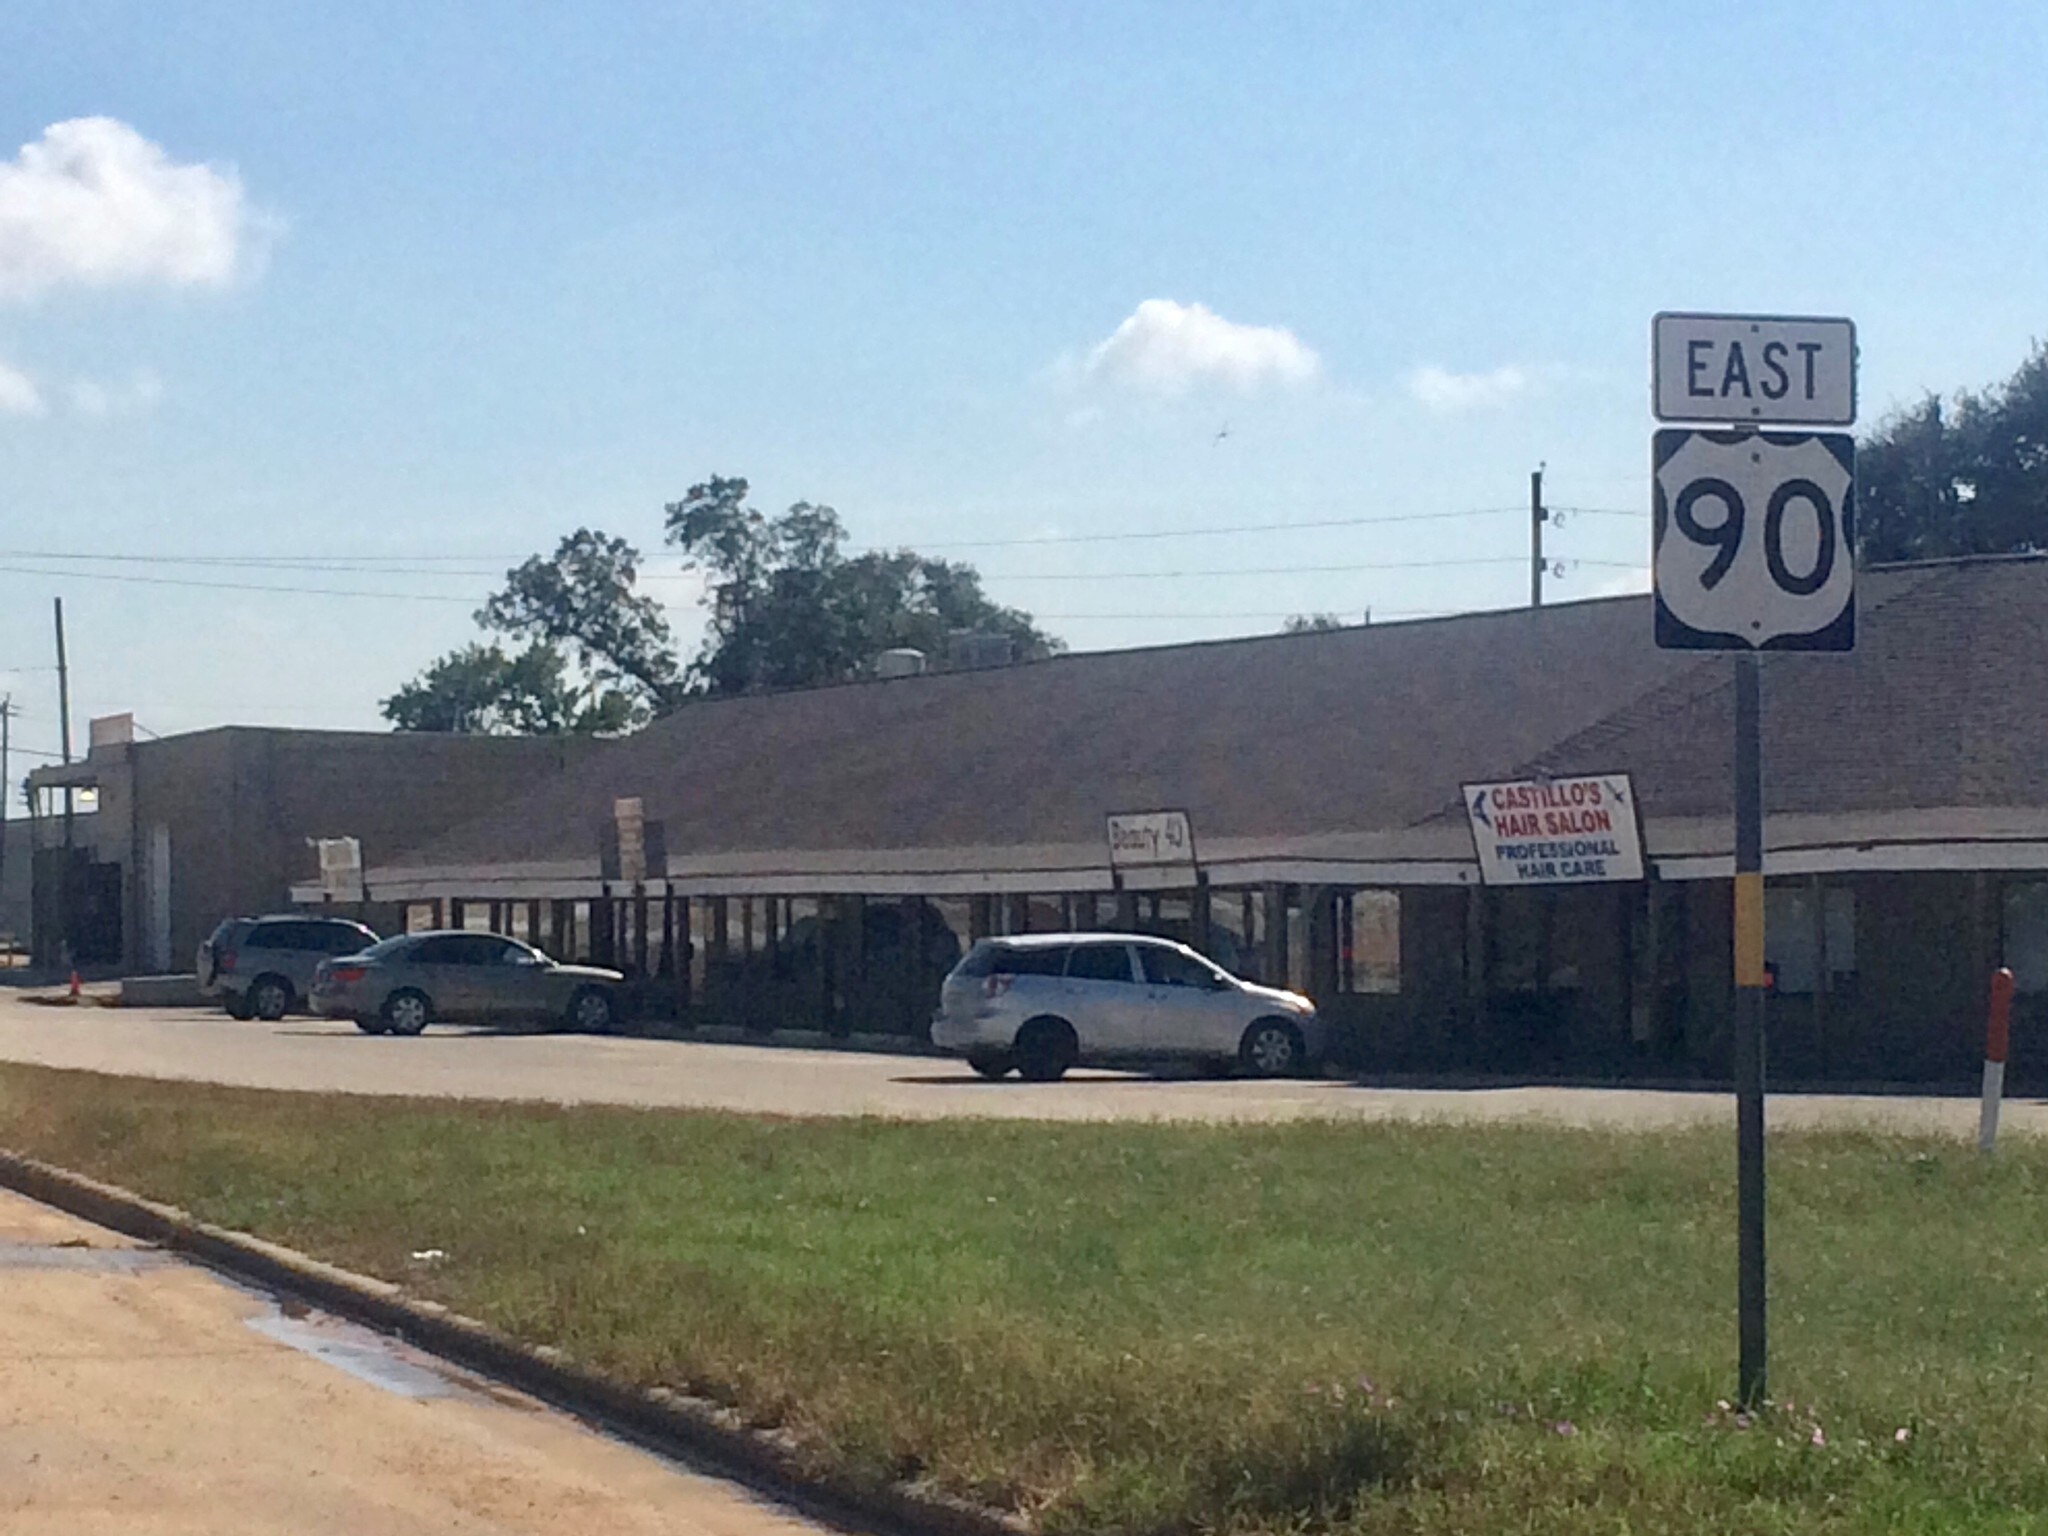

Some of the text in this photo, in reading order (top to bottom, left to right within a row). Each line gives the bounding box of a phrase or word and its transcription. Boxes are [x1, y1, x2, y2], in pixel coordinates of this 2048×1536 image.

[1687, 340, 1822, 400] EAST
[1674, 477, 1835, 596] 90
[1492, 782, 1602, 810] CASTILLO'S
[1495, 810, 1611, 837] HAIR SALON
[1496, 840, 1619, 859] PROFESSIONAL
[1518, 860, 1606, 878] HAIR CARE
